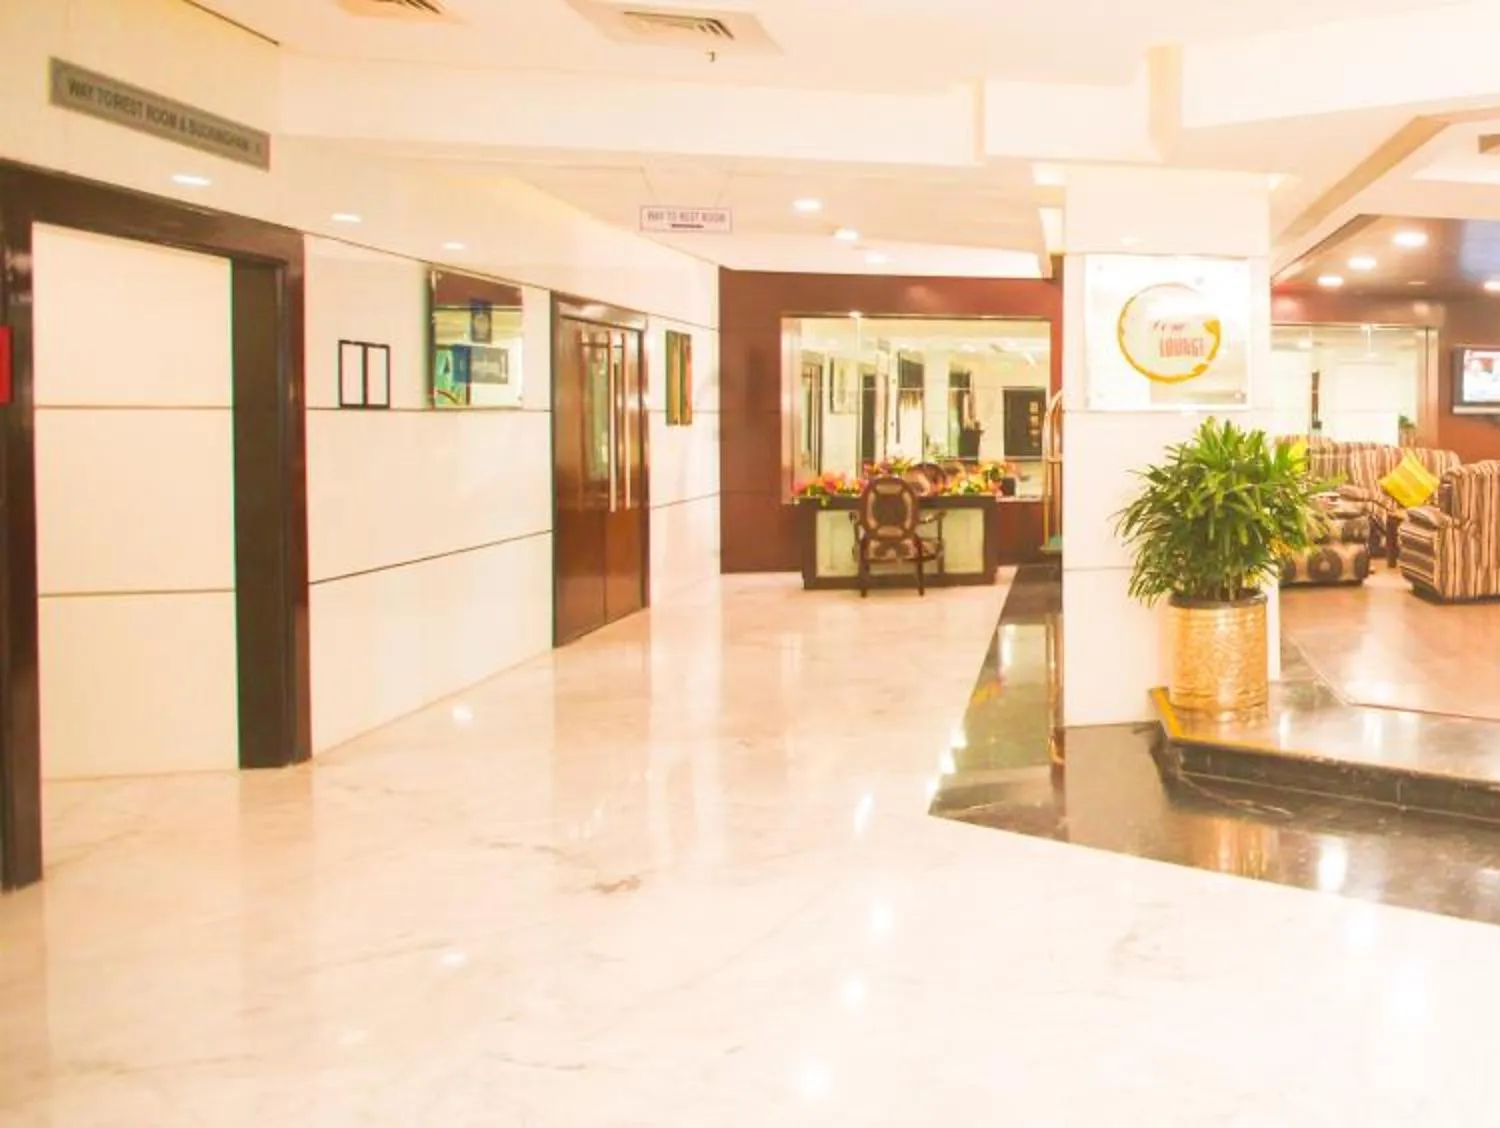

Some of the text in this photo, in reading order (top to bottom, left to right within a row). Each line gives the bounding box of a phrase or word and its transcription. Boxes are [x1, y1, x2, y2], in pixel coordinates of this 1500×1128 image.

[68, 79, 94, 98] WAY
[97, 88, 111, 106] TO
[111, 92, 143, 117] REST
[147, 104, 177, 129] ROOM
[1159, 336, 1205, 358] LOUNGE
